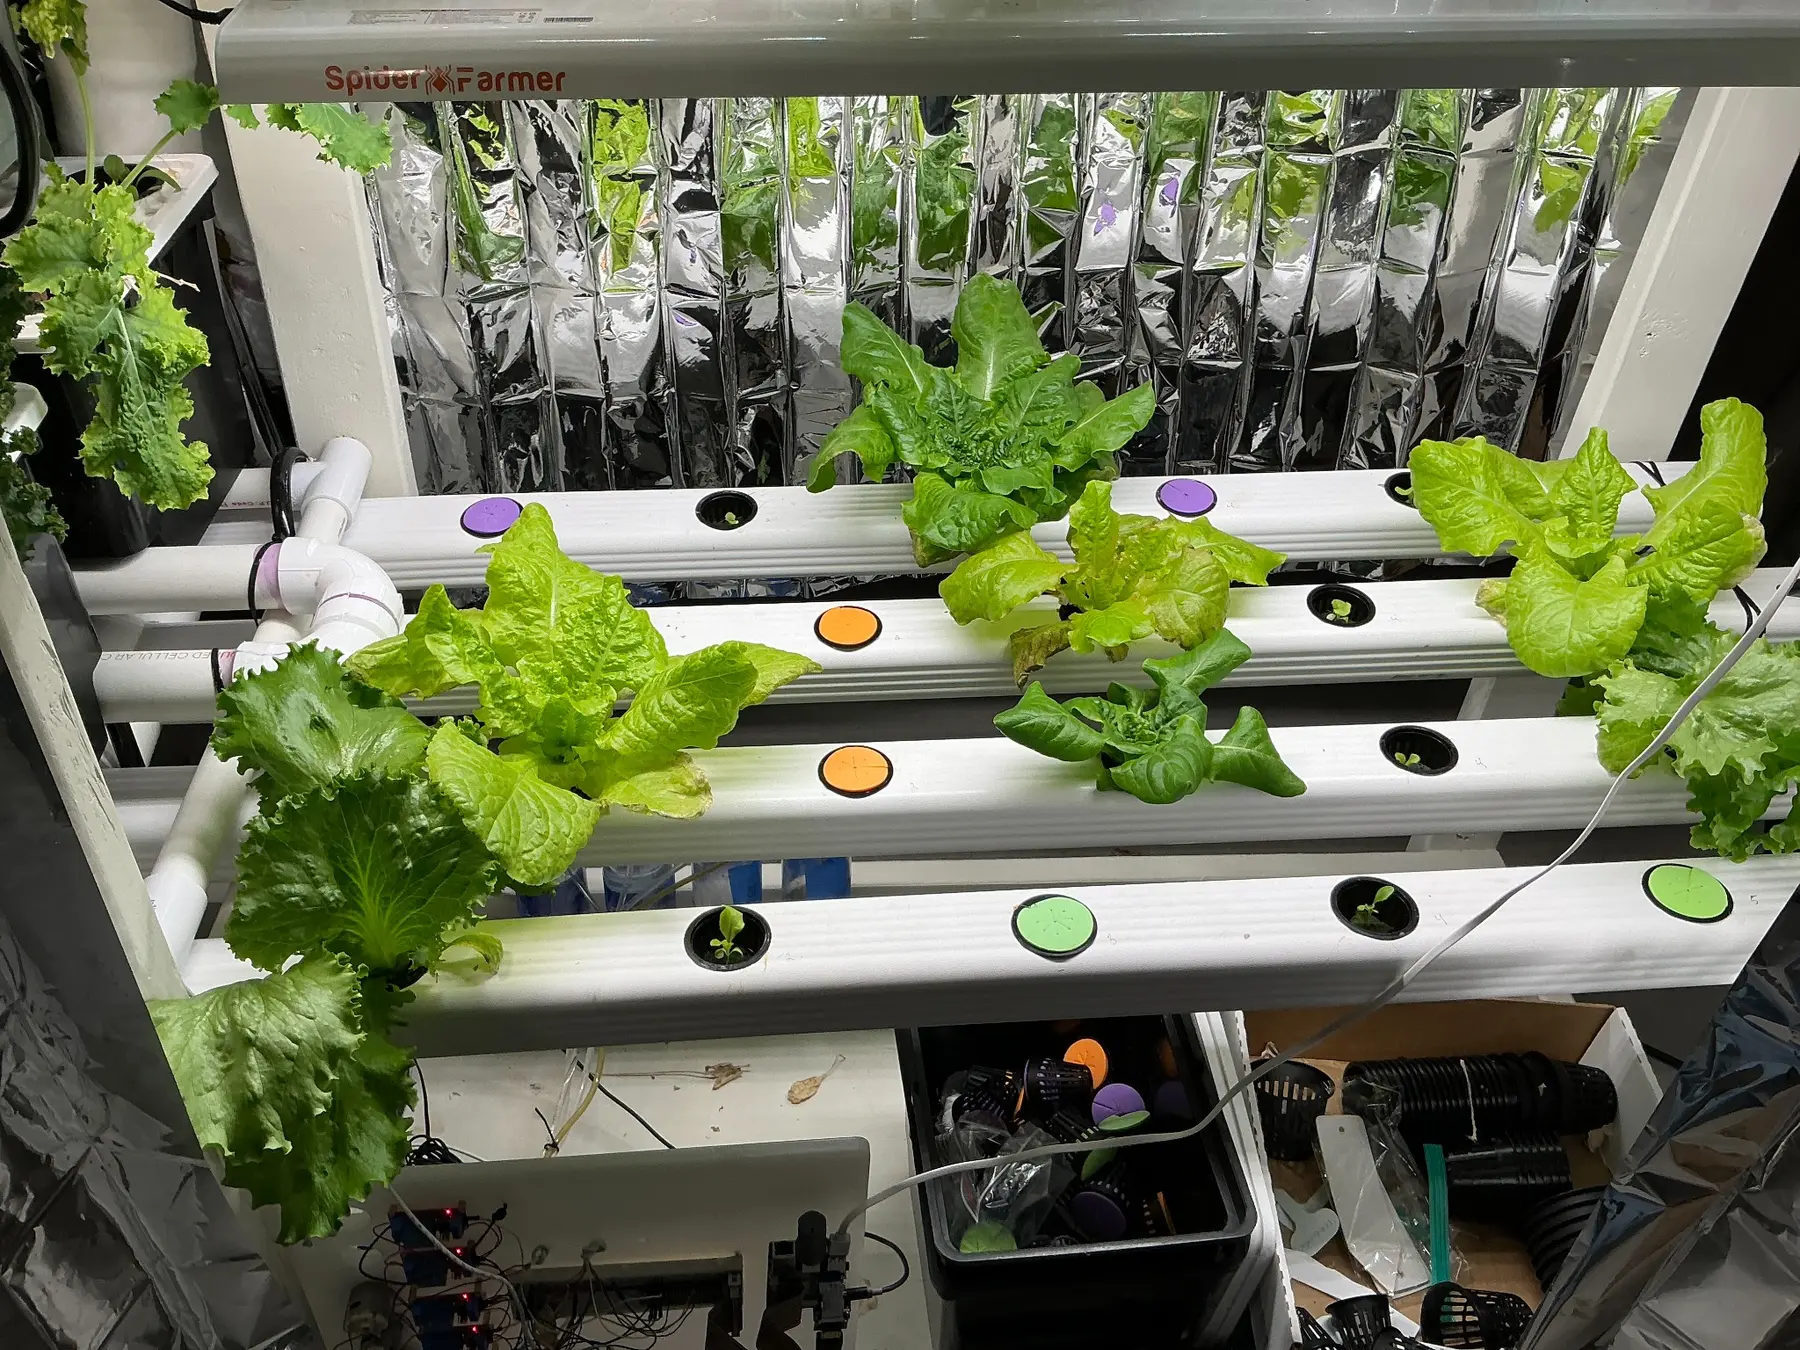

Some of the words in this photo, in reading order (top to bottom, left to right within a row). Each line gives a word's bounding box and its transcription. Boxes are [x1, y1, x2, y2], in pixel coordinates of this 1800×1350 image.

[324, 64, 419, 96] Spider
[457, 66, 567, 92] Farmer
[114, 651, 189, 661] CELLULAR
[1750, 894, 1759, 905] 5
[1434, 913, 1448, 925] 4
